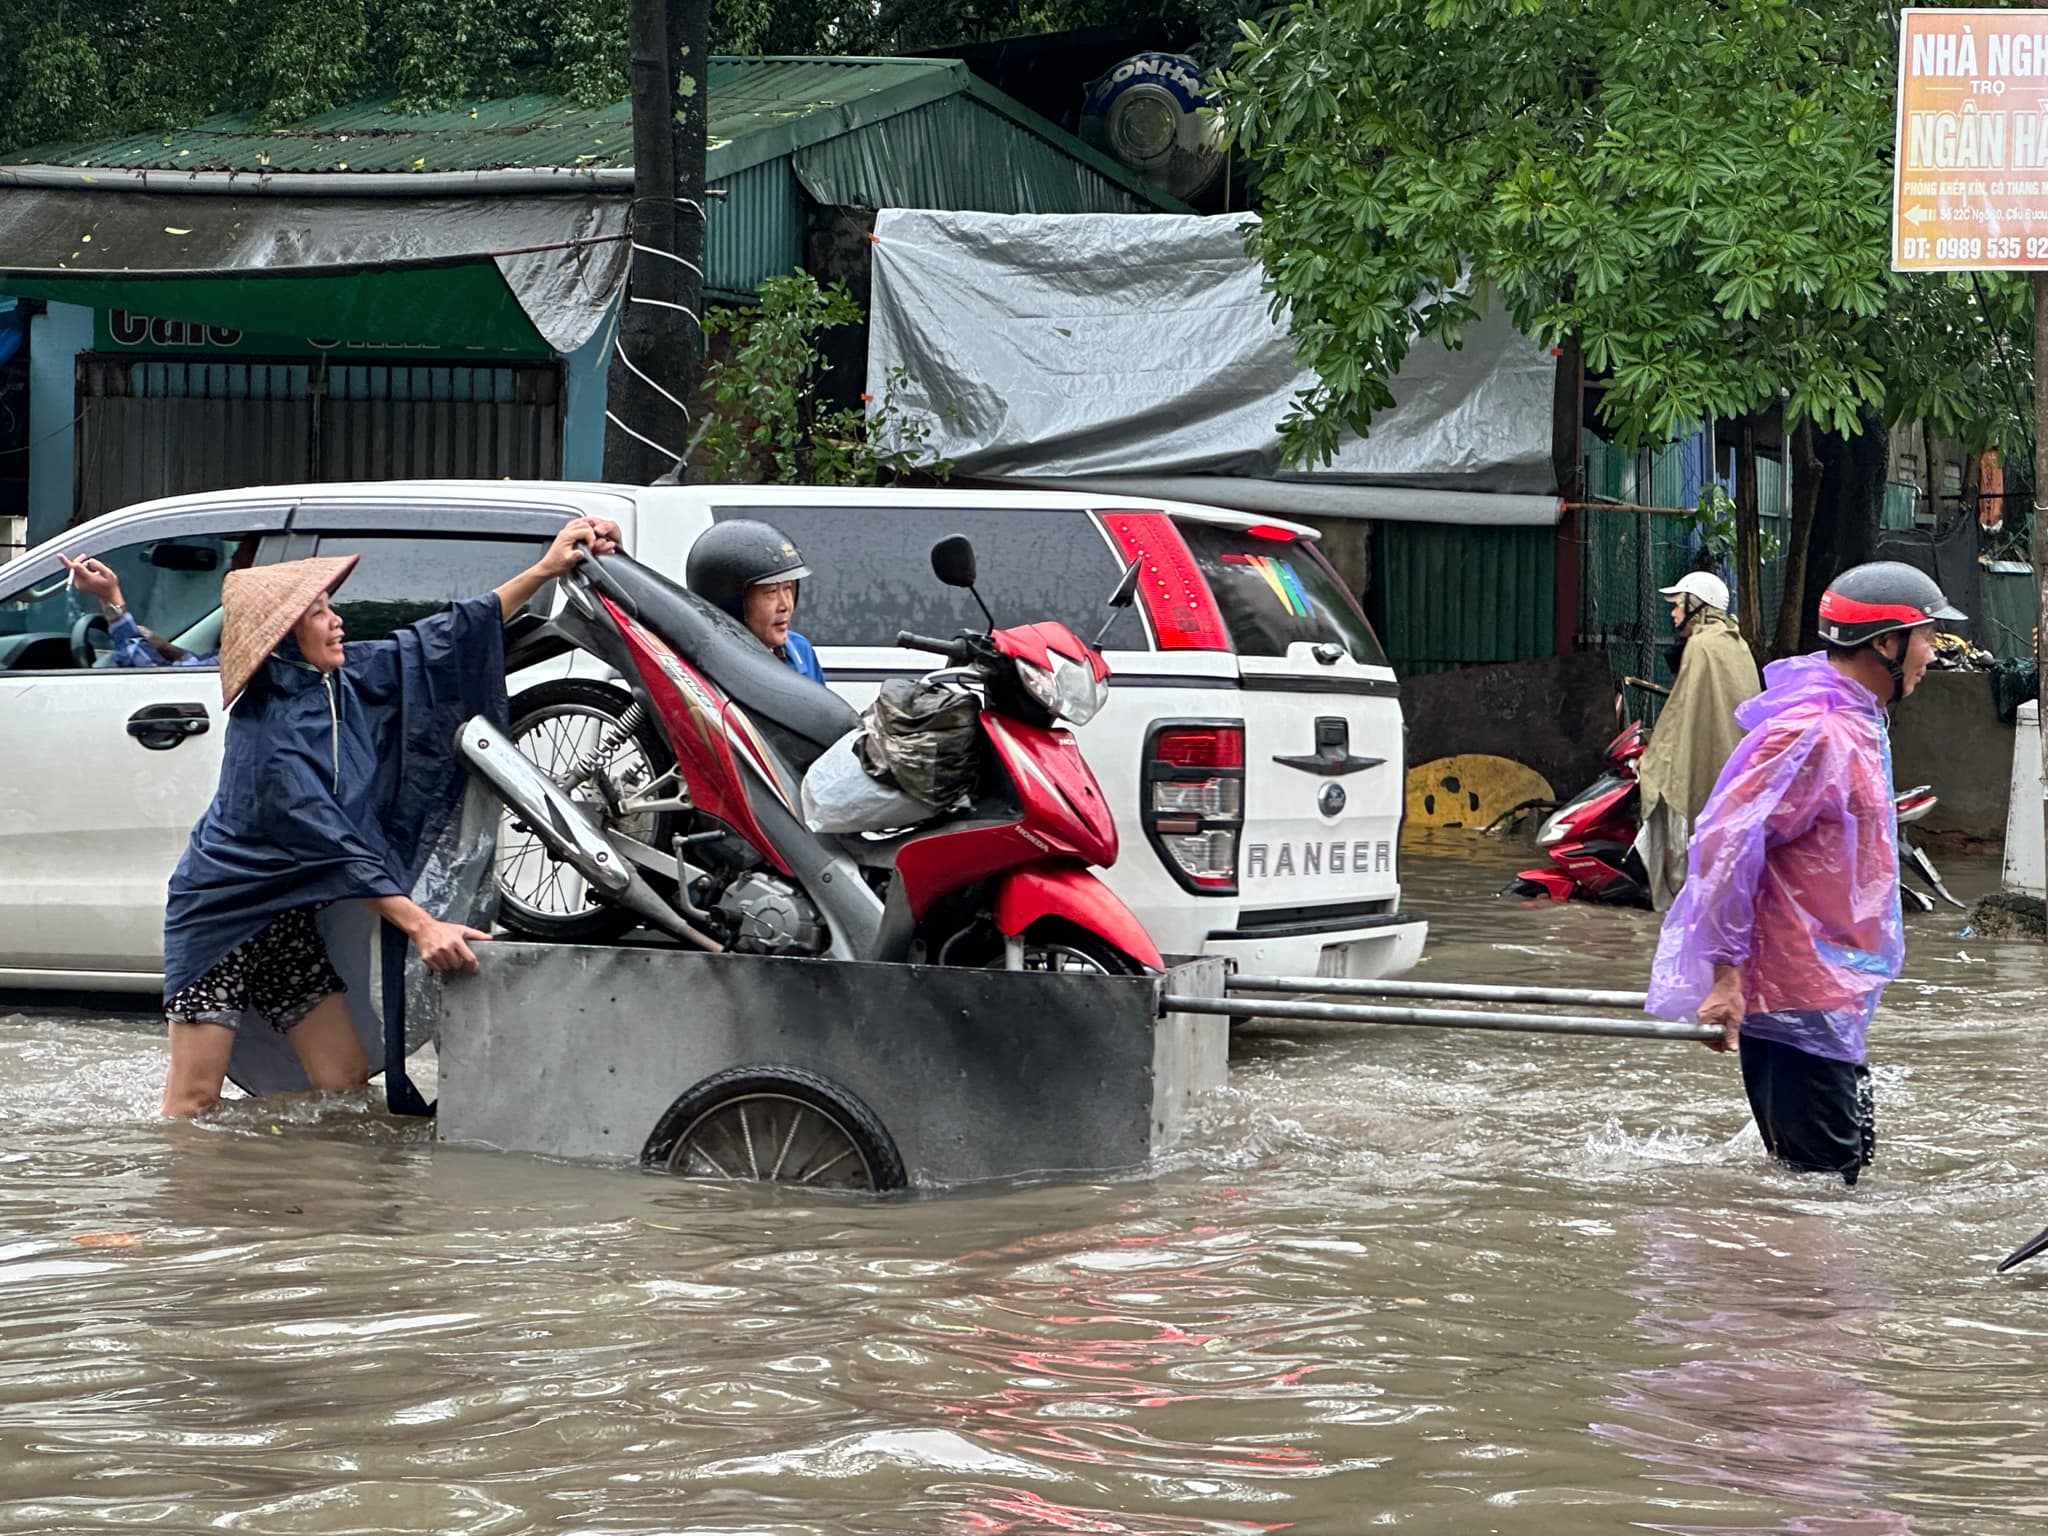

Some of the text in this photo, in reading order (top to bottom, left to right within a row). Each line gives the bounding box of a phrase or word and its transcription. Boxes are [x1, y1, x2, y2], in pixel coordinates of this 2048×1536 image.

[1911, 25, 1978, 77] NHÀ
[1970, 80, 2006, 97] TRỌ
[1907, 99, 2006, 171] NGÂN
[1953, 208, 1970, 220] 22C
[1903, 237, 1931, 259] ĐT:
[1936, 237, 1981, 259] 0989
[1986, 237, 2021, 259] 535
[1015, 825, 1049, 852] HONDA
[1247, 841, 1391, 878] RANGER
